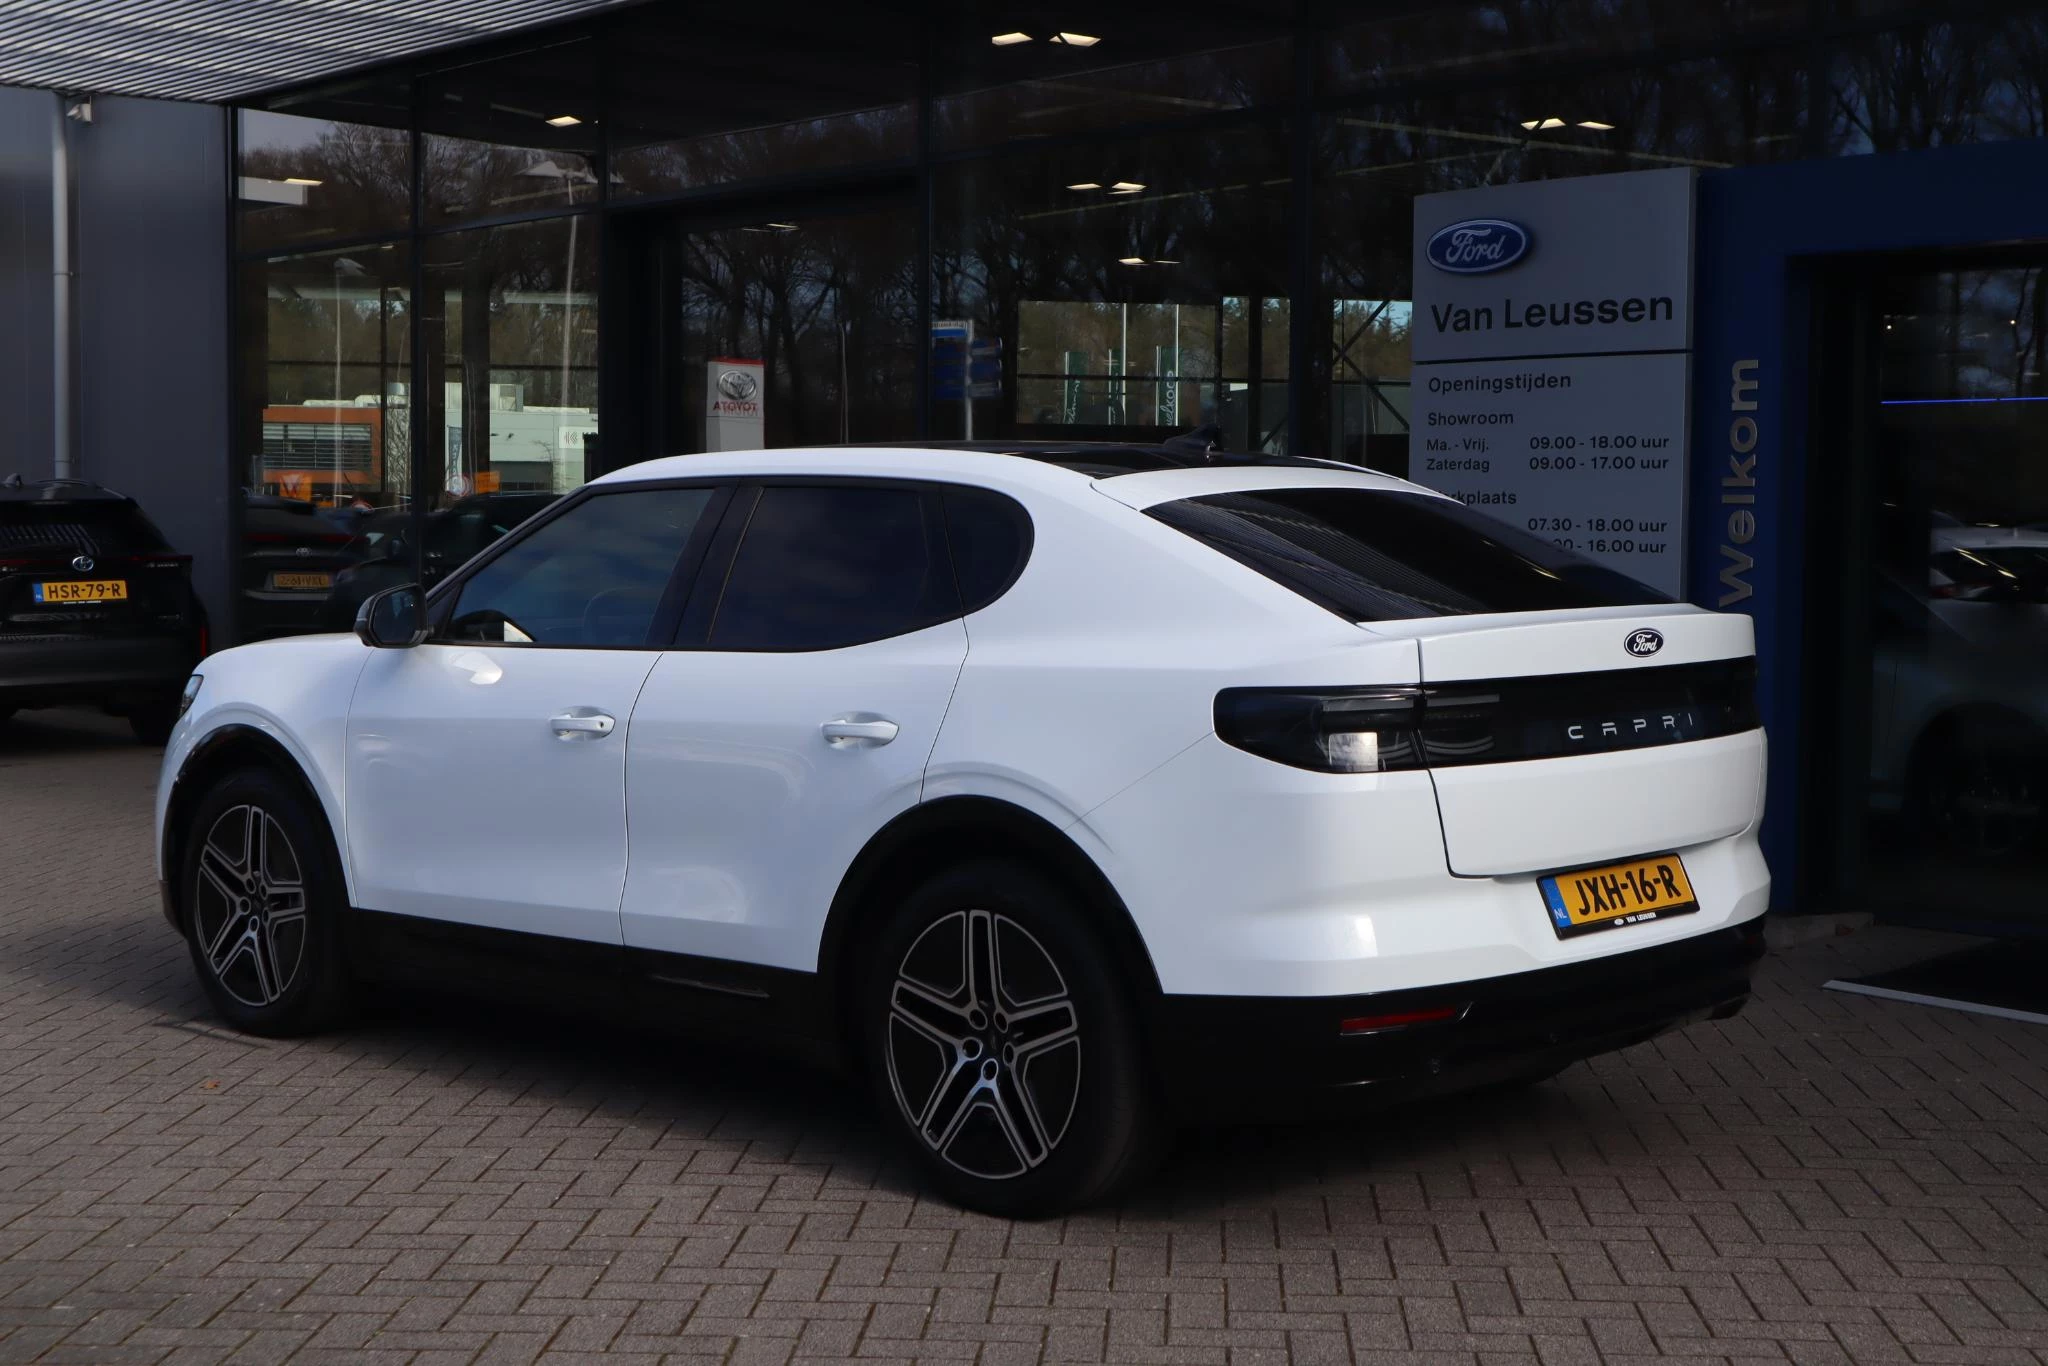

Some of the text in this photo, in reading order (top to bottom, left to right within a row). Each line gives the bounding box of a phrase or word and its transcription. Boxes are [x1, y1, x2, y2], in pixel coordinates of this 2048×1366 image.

[1445, 227, 1506, 264] Ford
[1430, 296, 1673, 333] Van Leussen
[1428, 373, 1571, 395] Openingstijden
[1427, 410, 1514, 427] Showroom
[1426, 438, 1451, 452] Ma.
[1462, 437, 1489, 453] Vrij.
[1529, 435, 1576, 450] 09.00
[1589, 435, 1637, 450] 18.00
[1641, 437, 1670, 449] uur
[1426, 458, 1490, 473] Zaterdag
[1529, 456, 1576, 471] 09.00
[1590, 455, 1636, 470] 17.00
[1640, 458, 1669, 470] uur
[1718, 359, 1759, 608] Welkom
[1441, 490, 1517, 506] rkplaats
[1528, 518, 1572, 532] 07.30
[1586, 518, 1634, 533] 18.00
[1638, 520, 1668, 533] uur
[1587, 539, 1635, 554] 16.00
[1638, 542, 1667, 554] uur
[48, 583, 121, 599] HSR-79-R
[1633, 633, 1659, 652] Ford
[1567, 712, 1694, 740] CAPRI
[1575, 864, 1682, 916] JXH-16-R
[1553, 907, 1568, 920] NL
